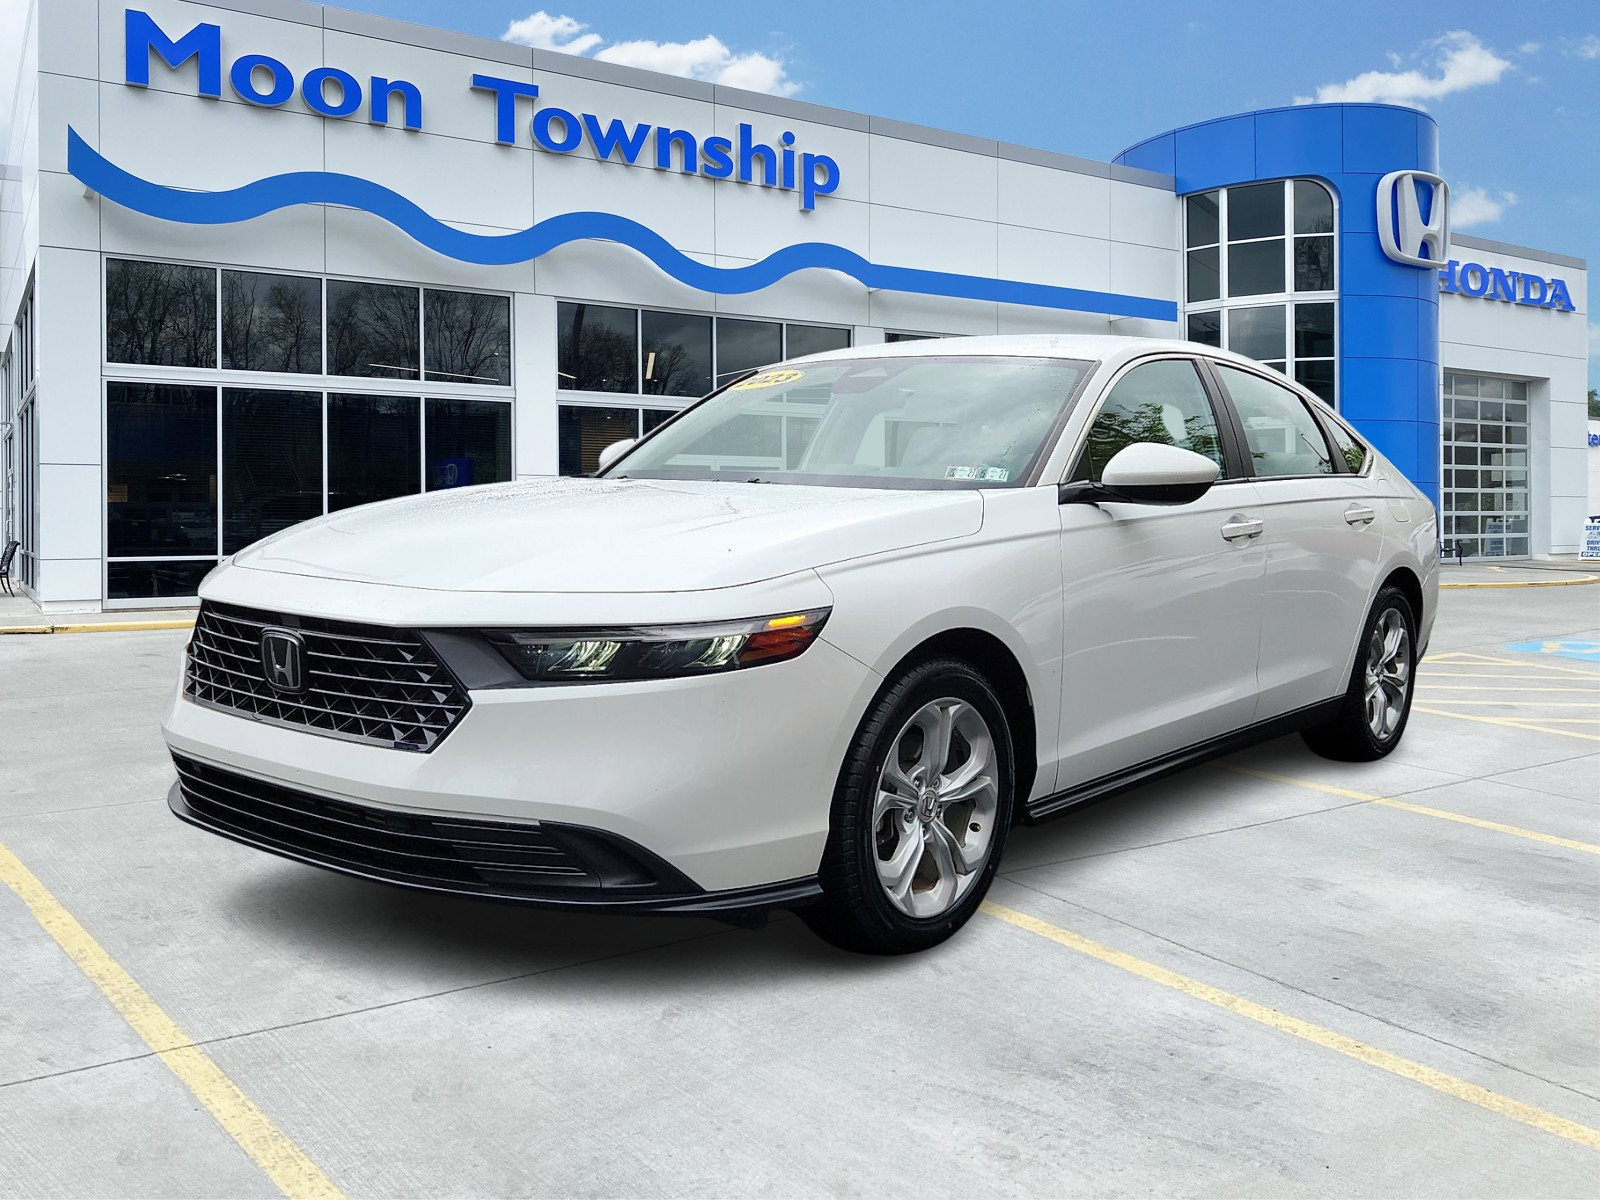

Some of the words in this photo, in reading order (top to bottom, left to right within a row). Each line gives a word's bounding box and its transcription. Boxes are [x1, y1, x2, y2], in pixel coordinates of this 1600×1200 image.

[125, 8, 422, 131] Moon
[470, 73, 840, 211] Township
[1439, 260, 1576, 312] HONDA
